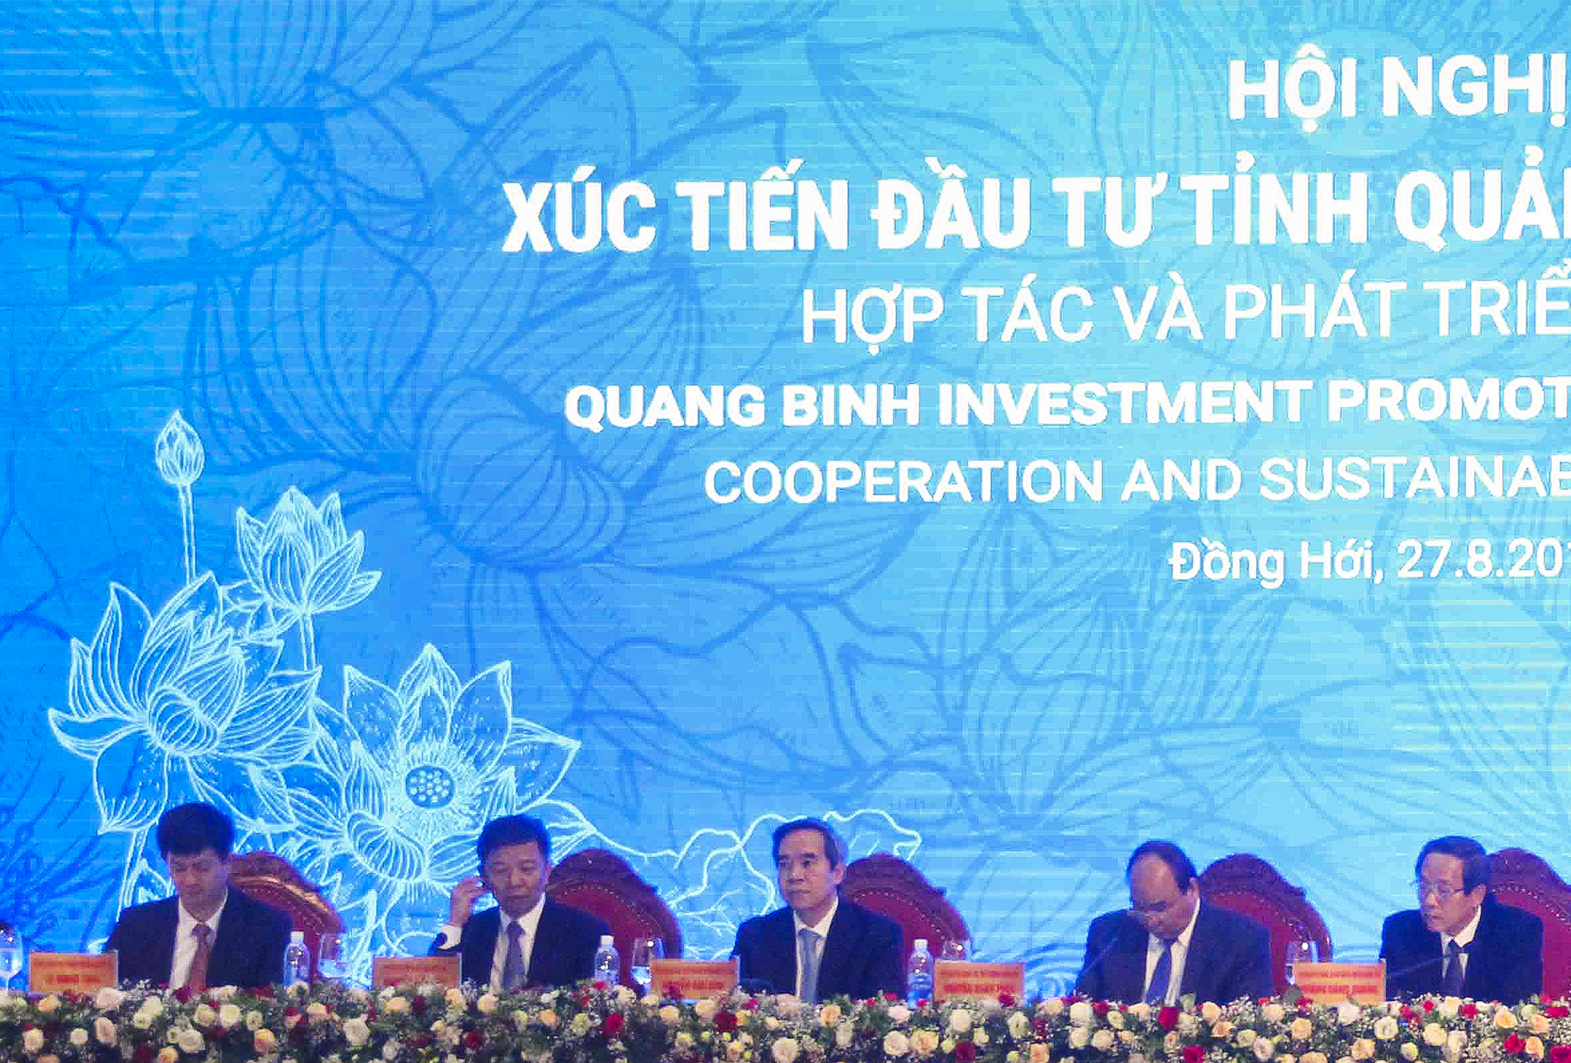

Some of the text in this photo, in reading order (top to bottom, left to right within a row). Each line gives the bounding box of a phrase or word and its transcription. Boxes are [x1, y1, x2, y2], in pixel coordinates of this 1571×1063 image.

[1229, 43, 1566, 133] HỘI NGHỊ
[502, 165, 656, 253] XÚC
[676, 158, 848, 251] TIẾN
[870, 157, 1030, 249] ĐẦU
[1053, 172, 1168, 247] TƯ
[1180, 151, 1368, 245] TỈNH
[803, 283, 944, 355] HỢP
[961, 273, 1093, 342] TÁC
[1113, 271, 1204, 341] VÀ
[1225, 269, 1408, 340] PHÁT
[565, 385, 765, 433] QUANG
[783, 384, 920, 426] BINH
[939, 380, 1314, 425] INVESTMENT
[705, 460, 1102, 504] COOPERATION
[1121, 458, 1242, 501] AND
[1168, 537, 1284, 589] Đồng
[1300, 538, 1383, 584] Hới,
